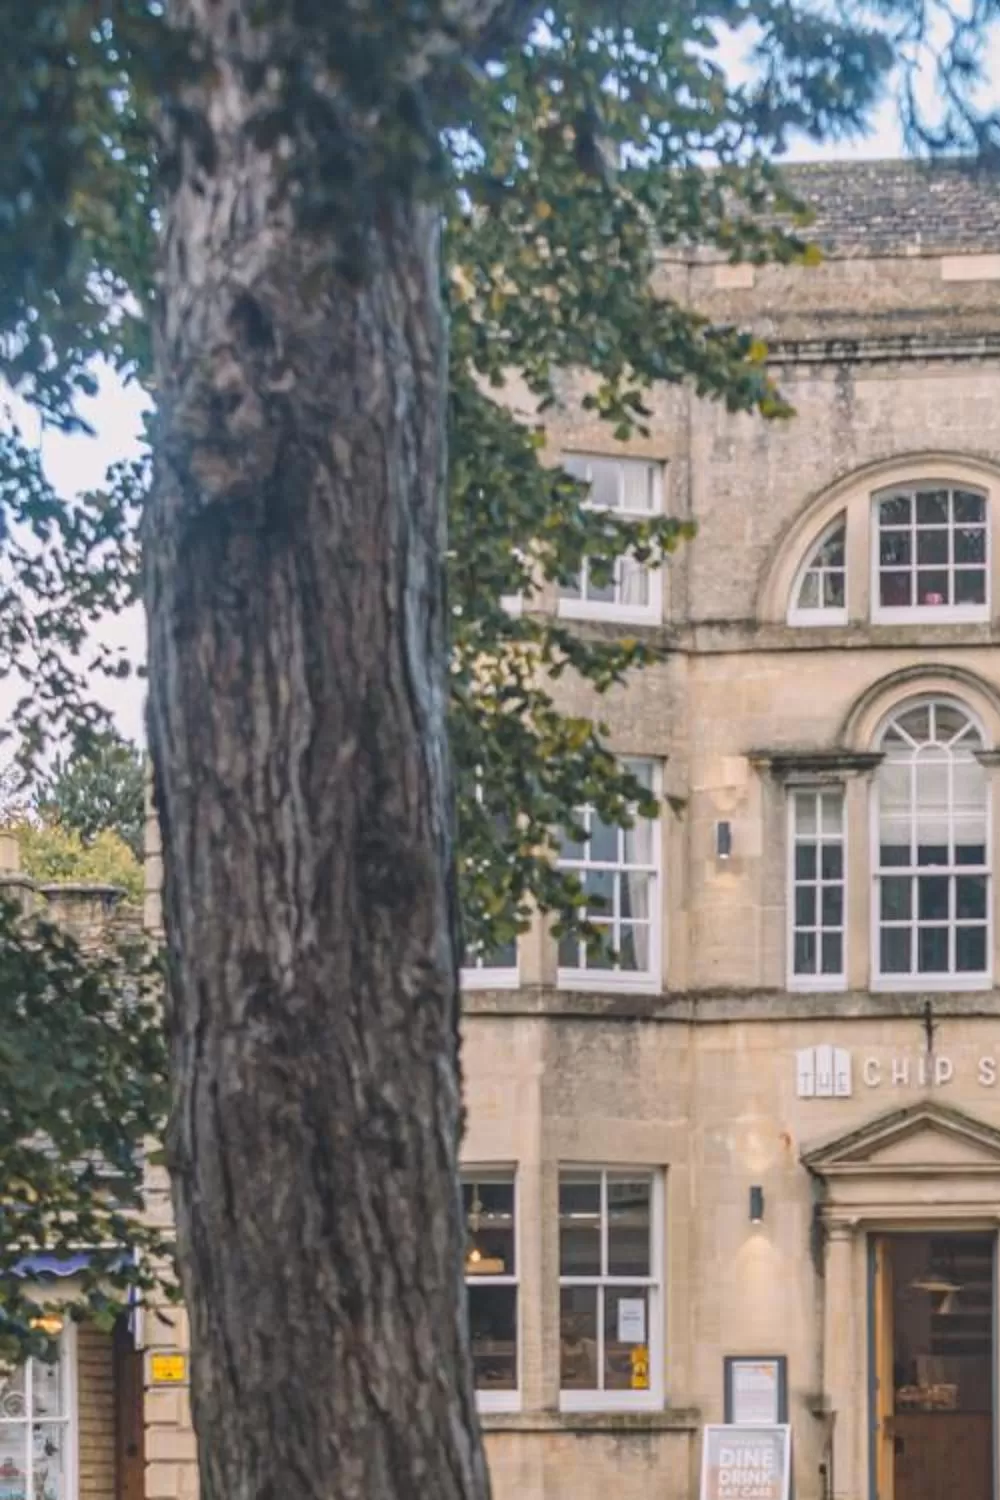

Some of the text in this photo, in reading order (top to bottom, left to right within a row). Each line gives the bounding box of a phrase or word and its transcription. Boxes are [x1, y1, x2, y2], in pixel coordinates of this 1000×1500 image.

[862, 1056, 953, 1088] CHIP
[719, 1447, 774, 1468] DINE
[718, 1469, 773, 1486] DRINK
